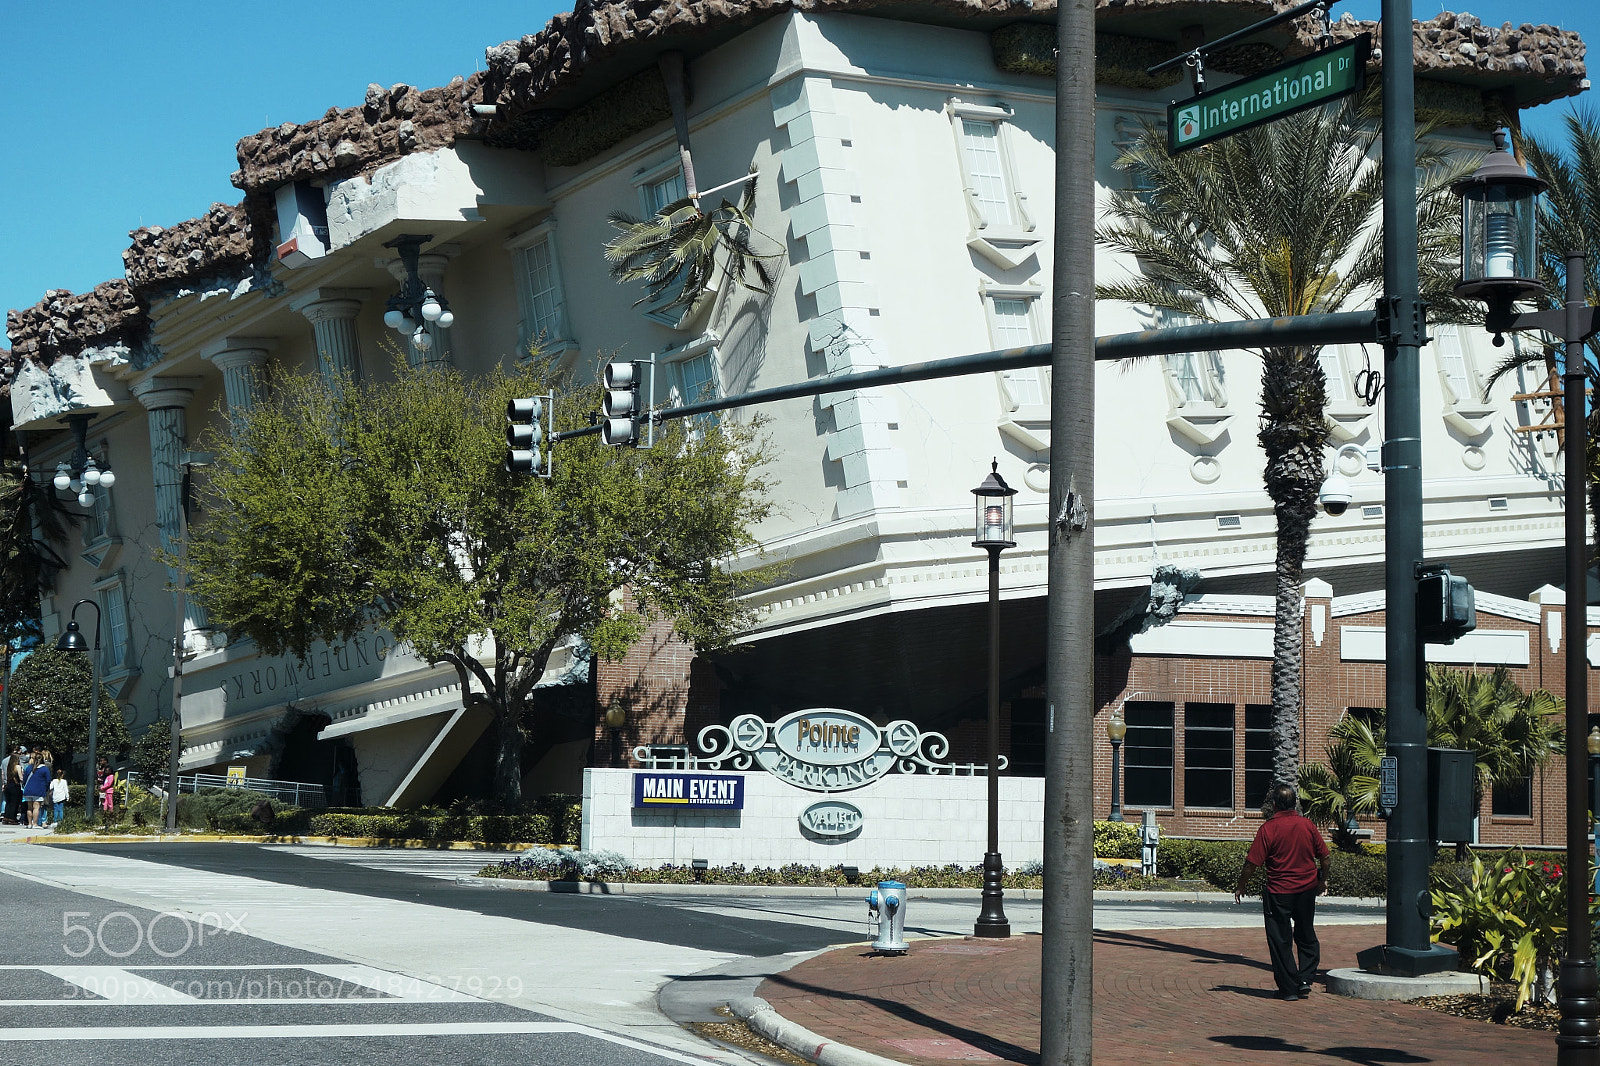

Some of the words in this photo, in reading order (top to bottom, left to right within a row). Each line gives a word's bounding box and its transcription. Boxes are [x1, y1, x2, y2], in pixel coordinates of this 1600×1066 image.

[1203, 62, 1332, 130] International
[1338, 57, 1350, 71] Dr
[798, 718, 860, 743] Pointe
[771, 753, 881, 787] PARKING
[643, 778, 684, 798] MAIN
[689, 779, 737, 799] EVENT
[805, 811, 858, 829] VALET
